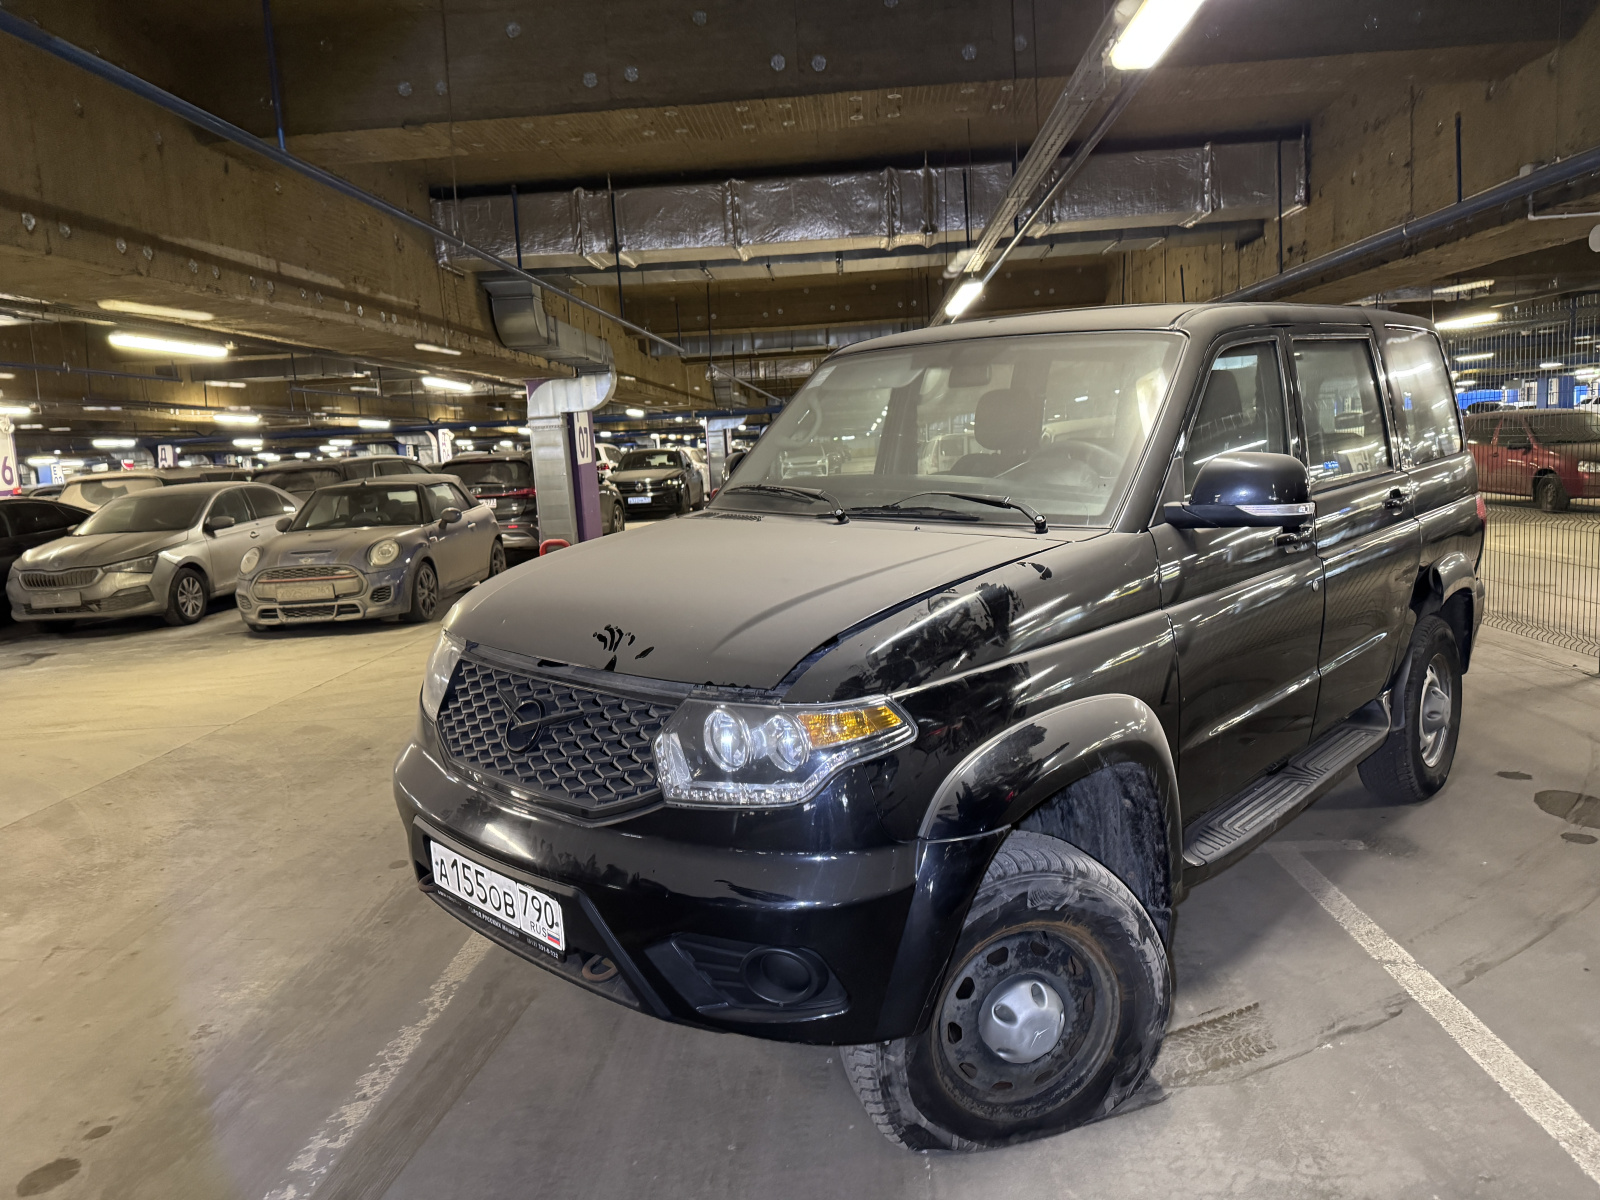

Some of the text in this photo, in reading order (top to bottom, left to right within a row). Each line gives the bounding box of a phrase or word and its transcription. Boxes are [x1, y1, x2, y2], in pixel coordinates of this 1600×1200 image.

[579, 426, 588, 458] 07
[439, 858, 555, 929] А155ОВ 790
[530, 920, 547, 938] RUS
